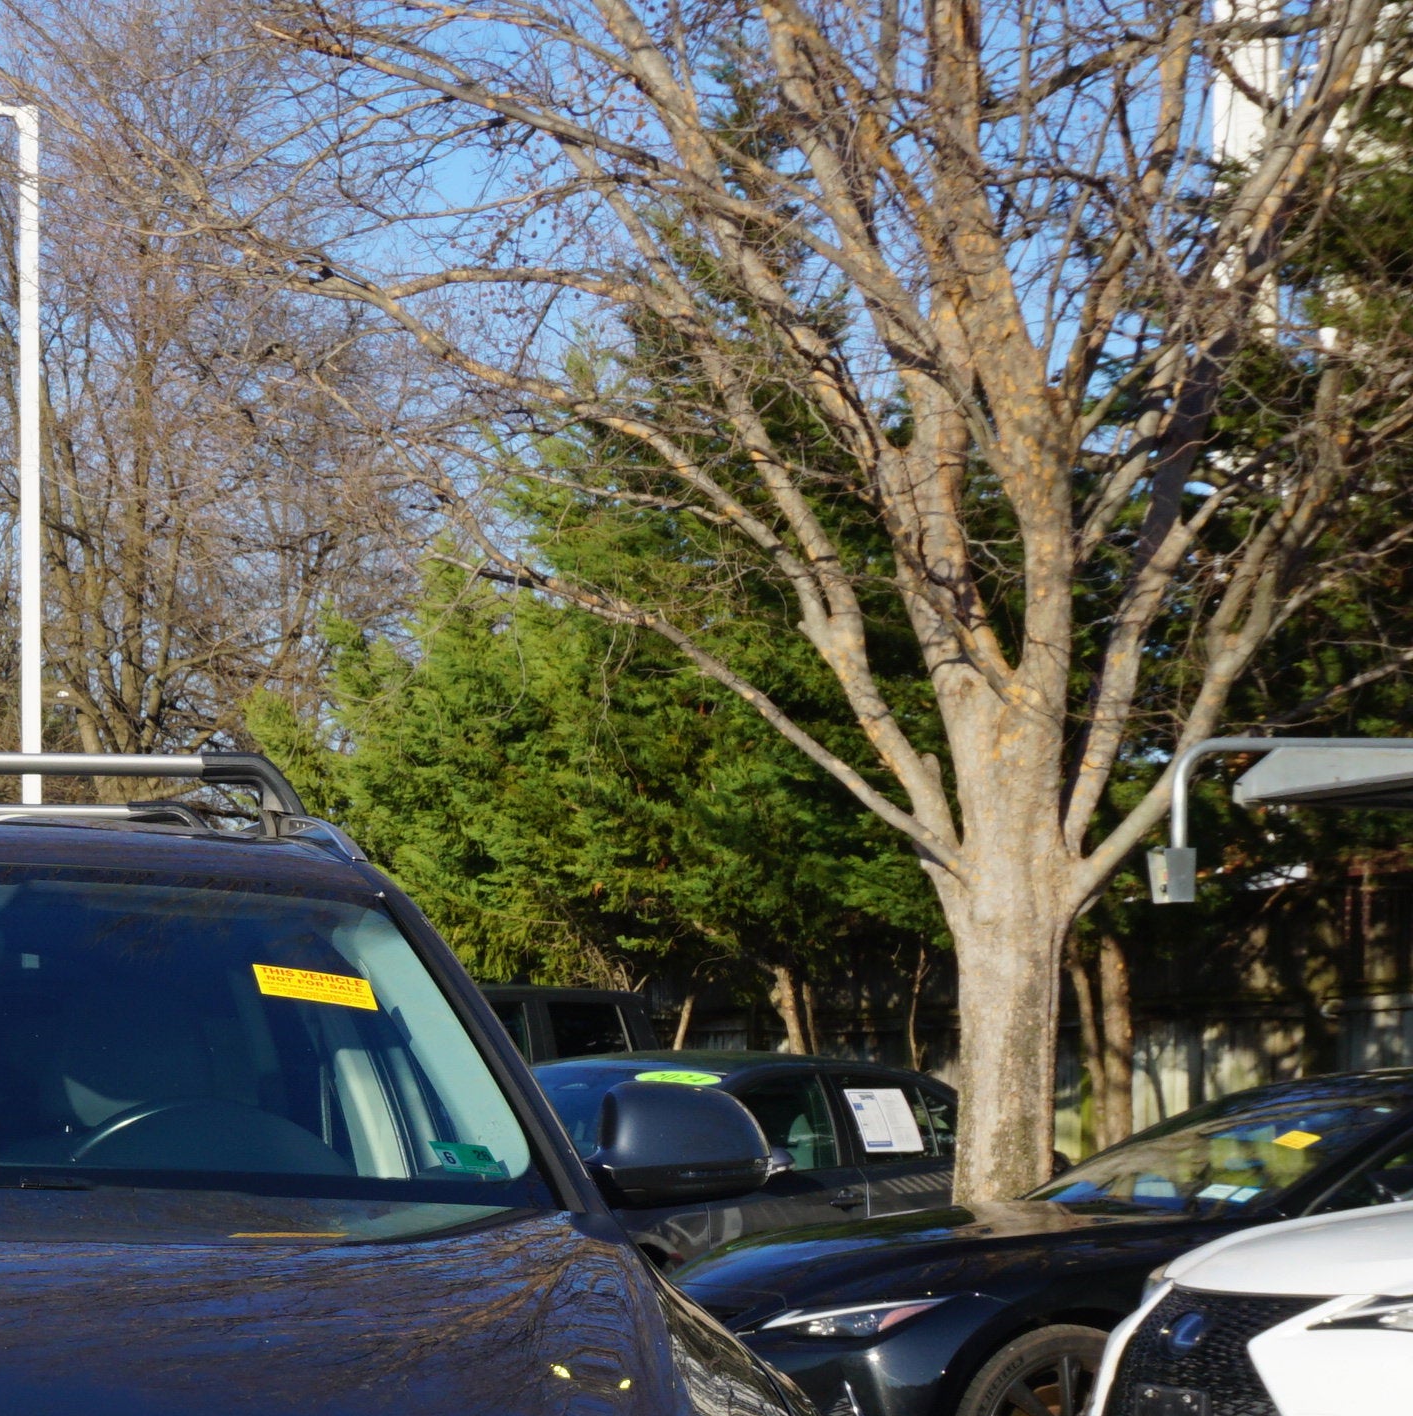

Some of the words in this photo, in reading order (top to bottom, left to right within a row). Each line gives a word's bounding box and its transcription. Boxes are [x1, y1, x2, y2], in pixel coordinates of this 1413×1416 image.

[260, 966, 295, 978] THIS
[299, 971, 365, 988] VEHICLE
[266, 975, 293, 984] NOT
[297, 978, 325, 988] FOR
[329, 983, 364, 994] SALE
[442, 1151, 457, 1165] 6
